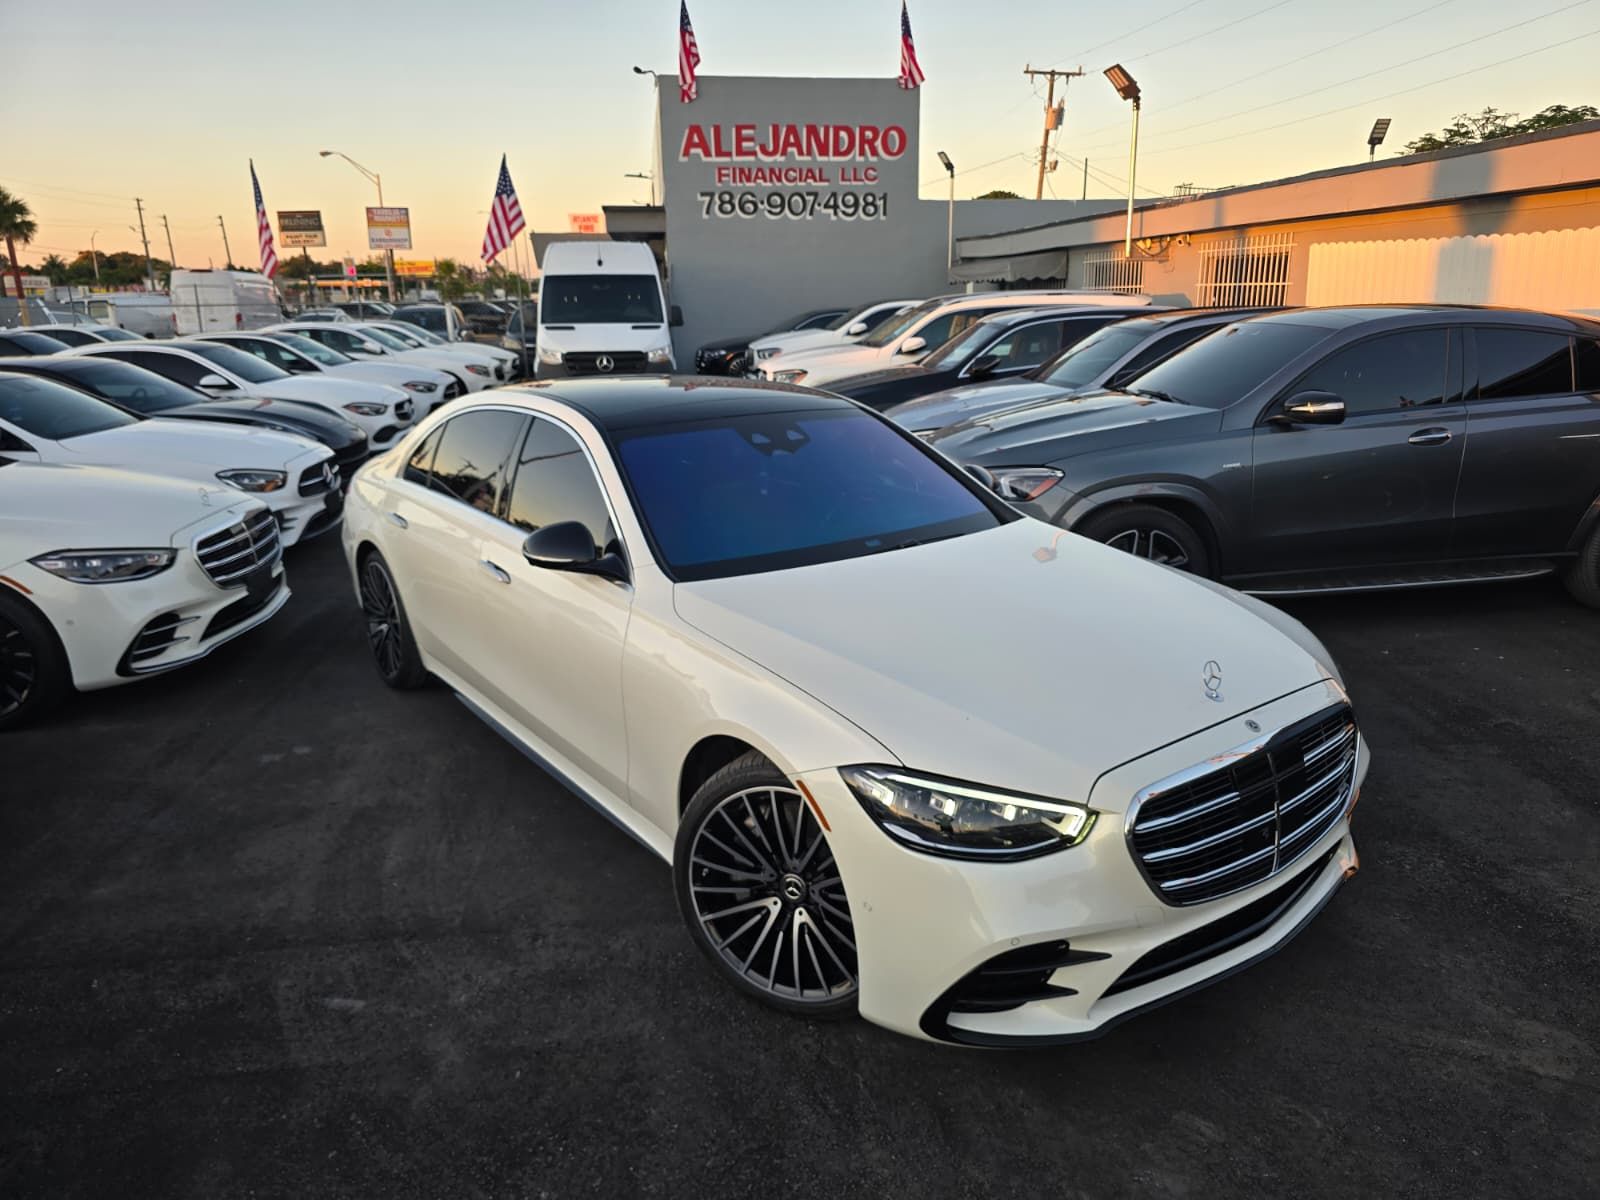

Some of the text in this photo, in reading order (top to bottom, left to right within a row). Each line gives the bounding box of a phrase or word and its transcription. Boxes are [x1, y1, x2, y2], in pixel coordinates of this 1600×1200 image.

[680, 124, 907, 160] ALEJANDRO
[715, 166, 879, 186] FINANCIAL LLC
